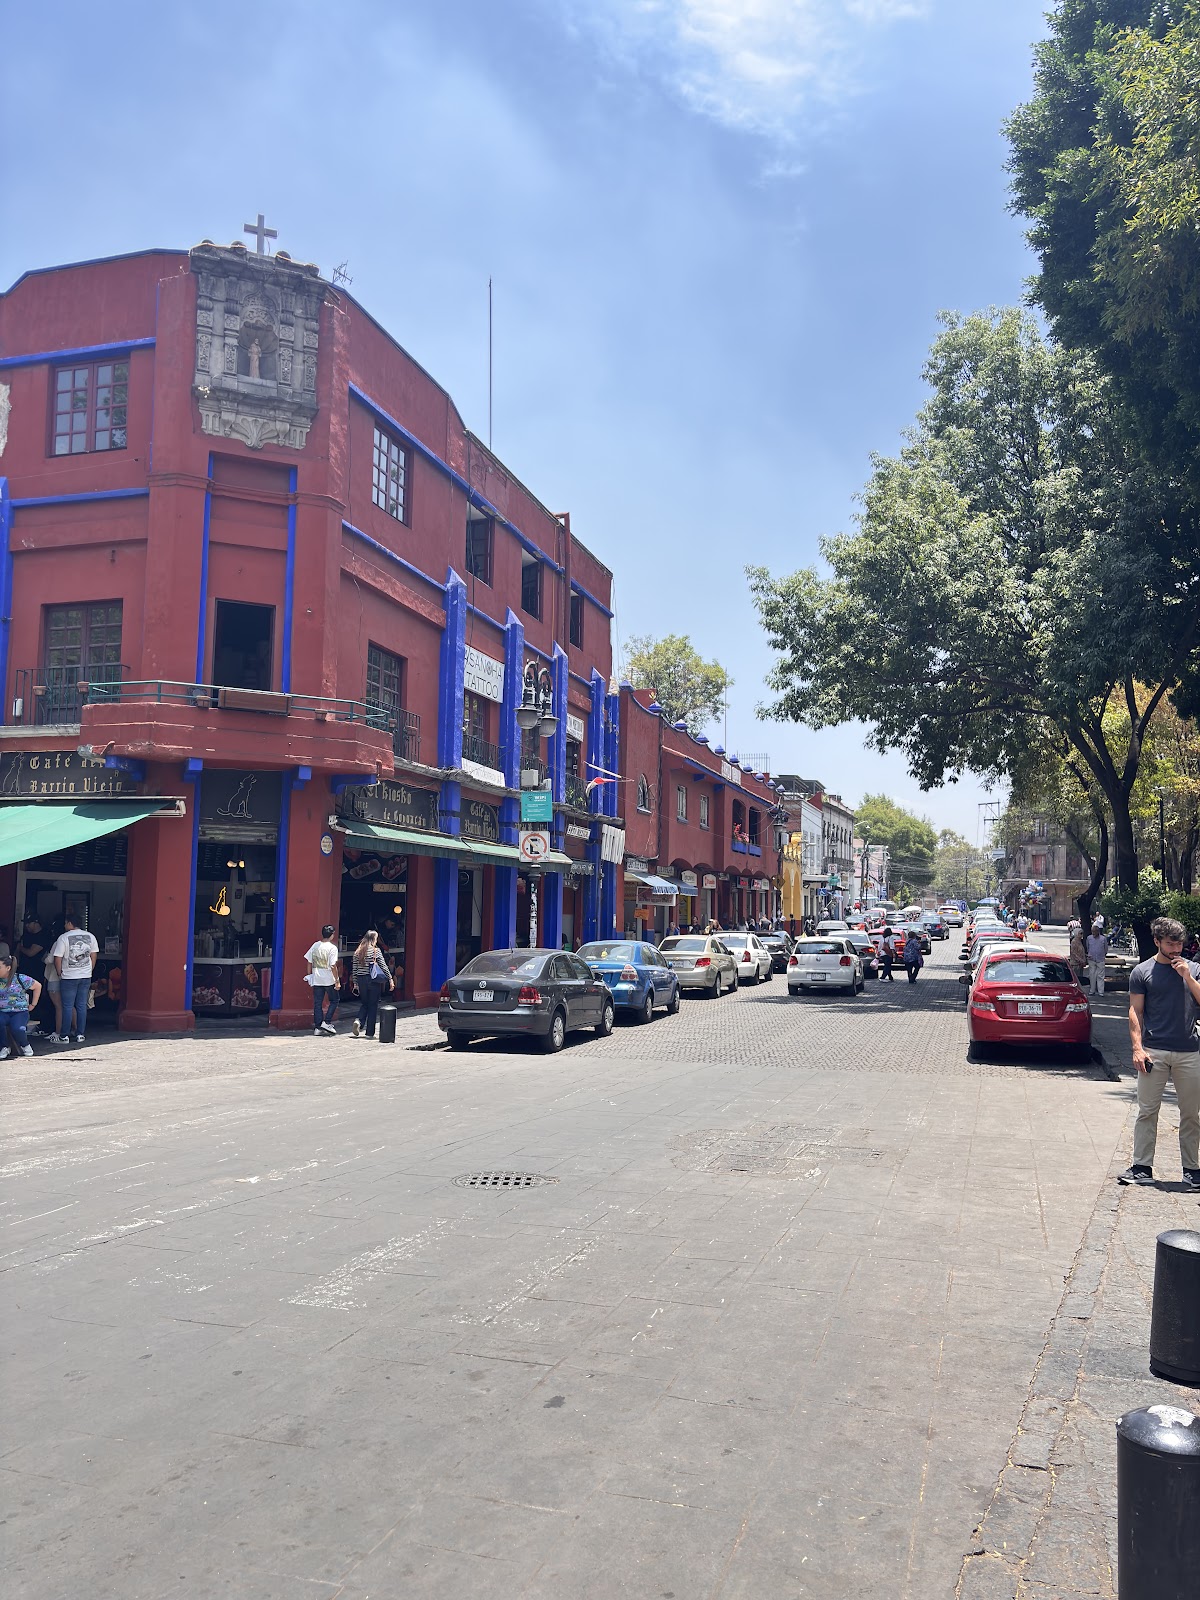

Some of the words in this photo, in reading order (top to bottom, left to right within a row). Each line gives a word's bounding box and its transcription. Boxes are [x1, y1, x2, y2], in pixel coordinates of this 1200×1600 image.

[466, 671, 499, 699] TATTOO
[29, 753, 73, 770] Café
[30, 777, 75, 794] Barrio
[83, 776, 123, 796] Viejo
[383, 807, 391, 820] de
